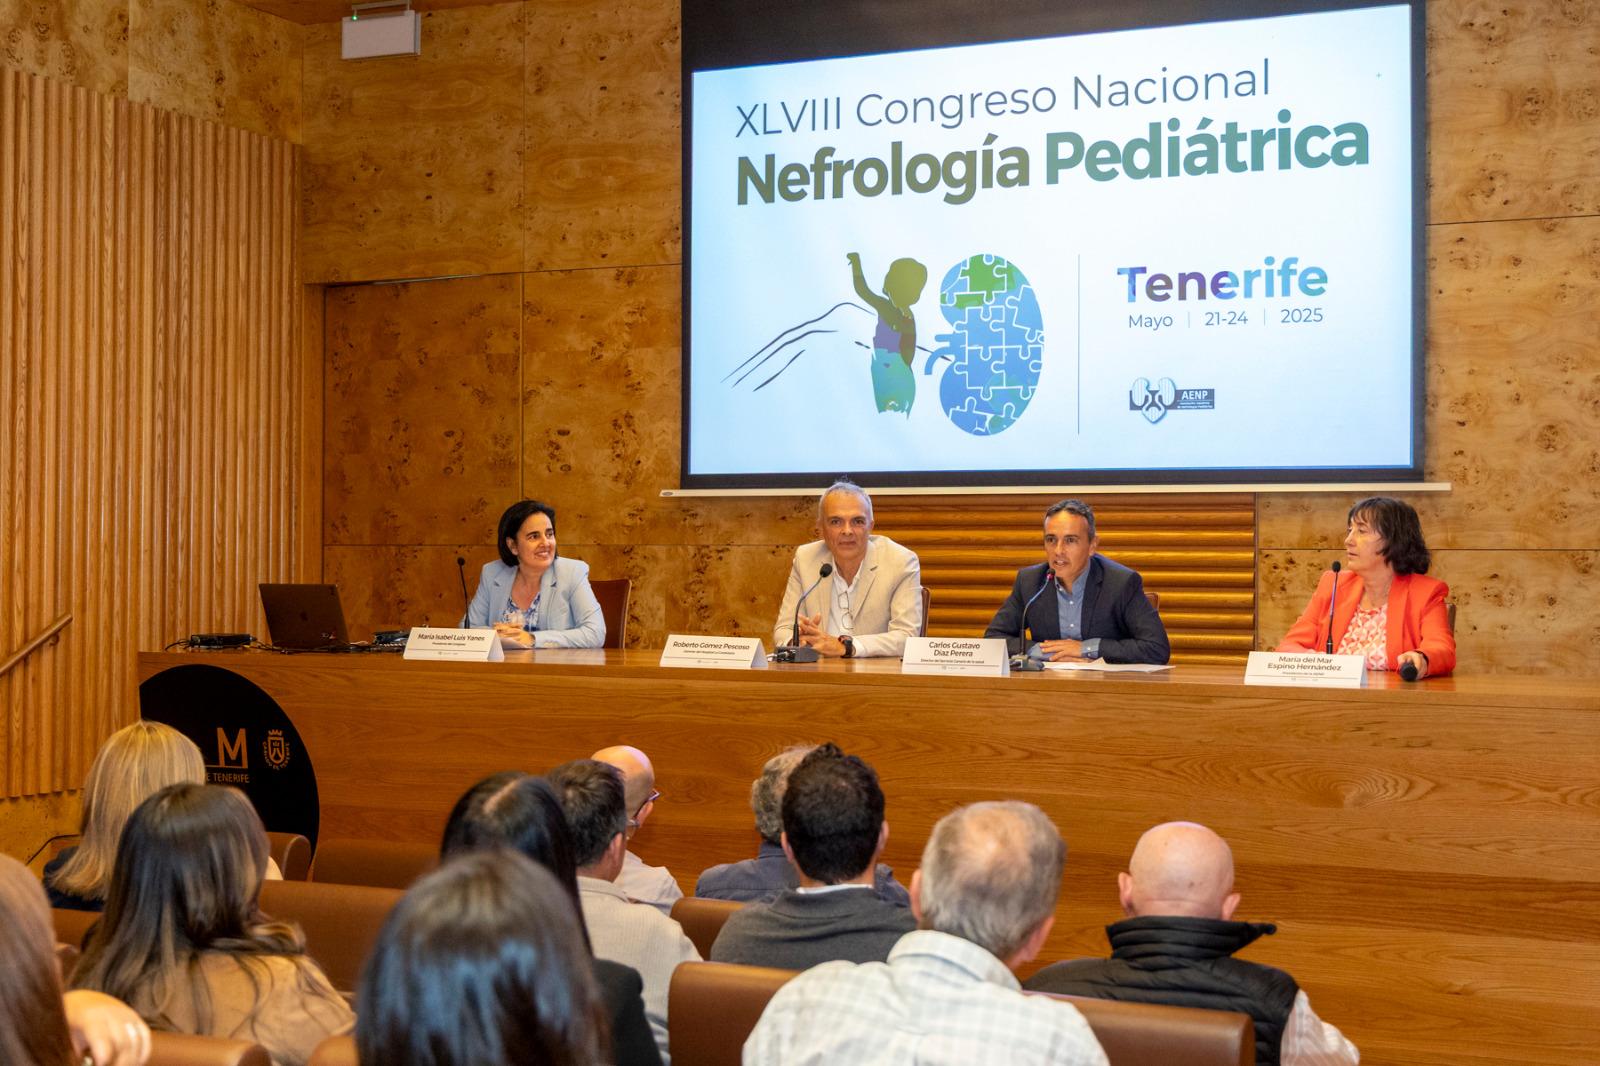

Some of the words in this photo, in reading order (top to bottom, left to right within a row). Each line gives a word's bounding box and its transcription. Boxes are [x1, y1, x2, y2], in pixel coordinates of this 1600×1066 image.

[735, 97, 841, 138] XLVIII
[856, 87, 1057, 129] Congreso
[1074, 58, 1269, 110] Nacional
[737, 132, 1030, 205] Nefrología
[1046, 109, 1369, 185] Pediátrica
[1117, 256, 1328, 303] Tenerife
[1128, 314, 1173, 331] Mayo
[1204, 311, 1249, 326] 21-24
[1280, 307, 1324, 323] 2025
[1181, 390, 1209, 400] AENP
[435, 633, 453, 641] Isabel
[673, 640, 699, 648] Roberto
[929, 641, 951, 649] Carlos
[951, 641, 981, 650] Gustavo
[950, 649, 974, 657] Perera
[1267, 662, 1296, 671] Espino
[217, 727, 248, 769] M
[213, 773, 250, 783] TENERIFE
